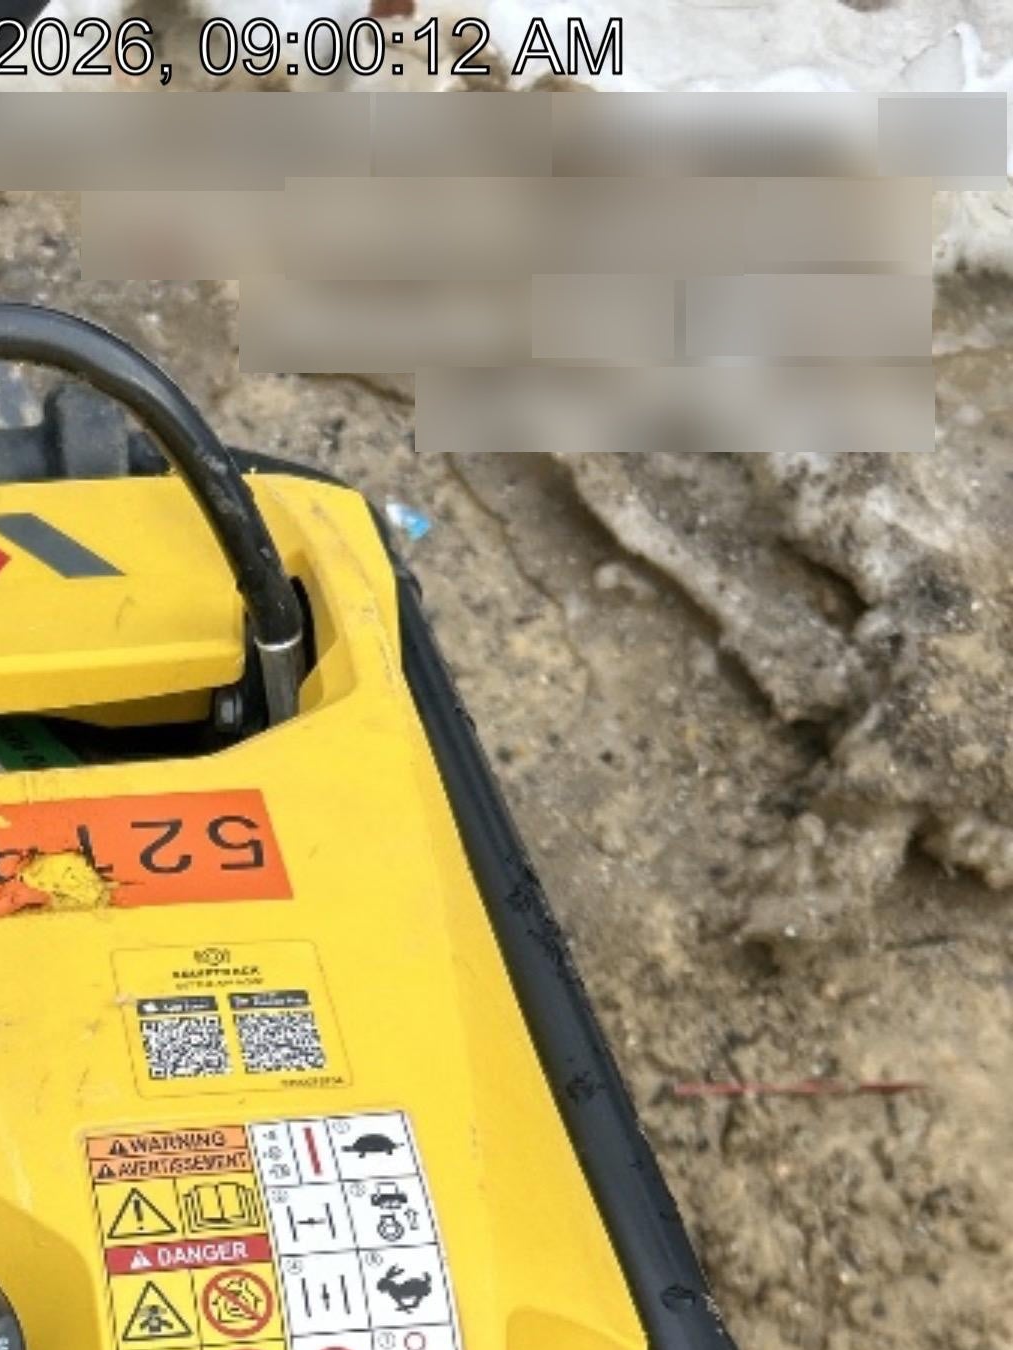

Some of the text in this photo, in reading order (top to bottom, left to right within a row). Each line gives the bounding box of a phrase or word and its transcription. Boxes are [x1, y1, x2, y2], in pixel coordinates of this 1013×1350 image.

[129, 1131, 226, 1153] WARNING
[118, 1151, 248, 1177] AVERTISSEMENT
[157, 1241, 249, 1267] DANGER
